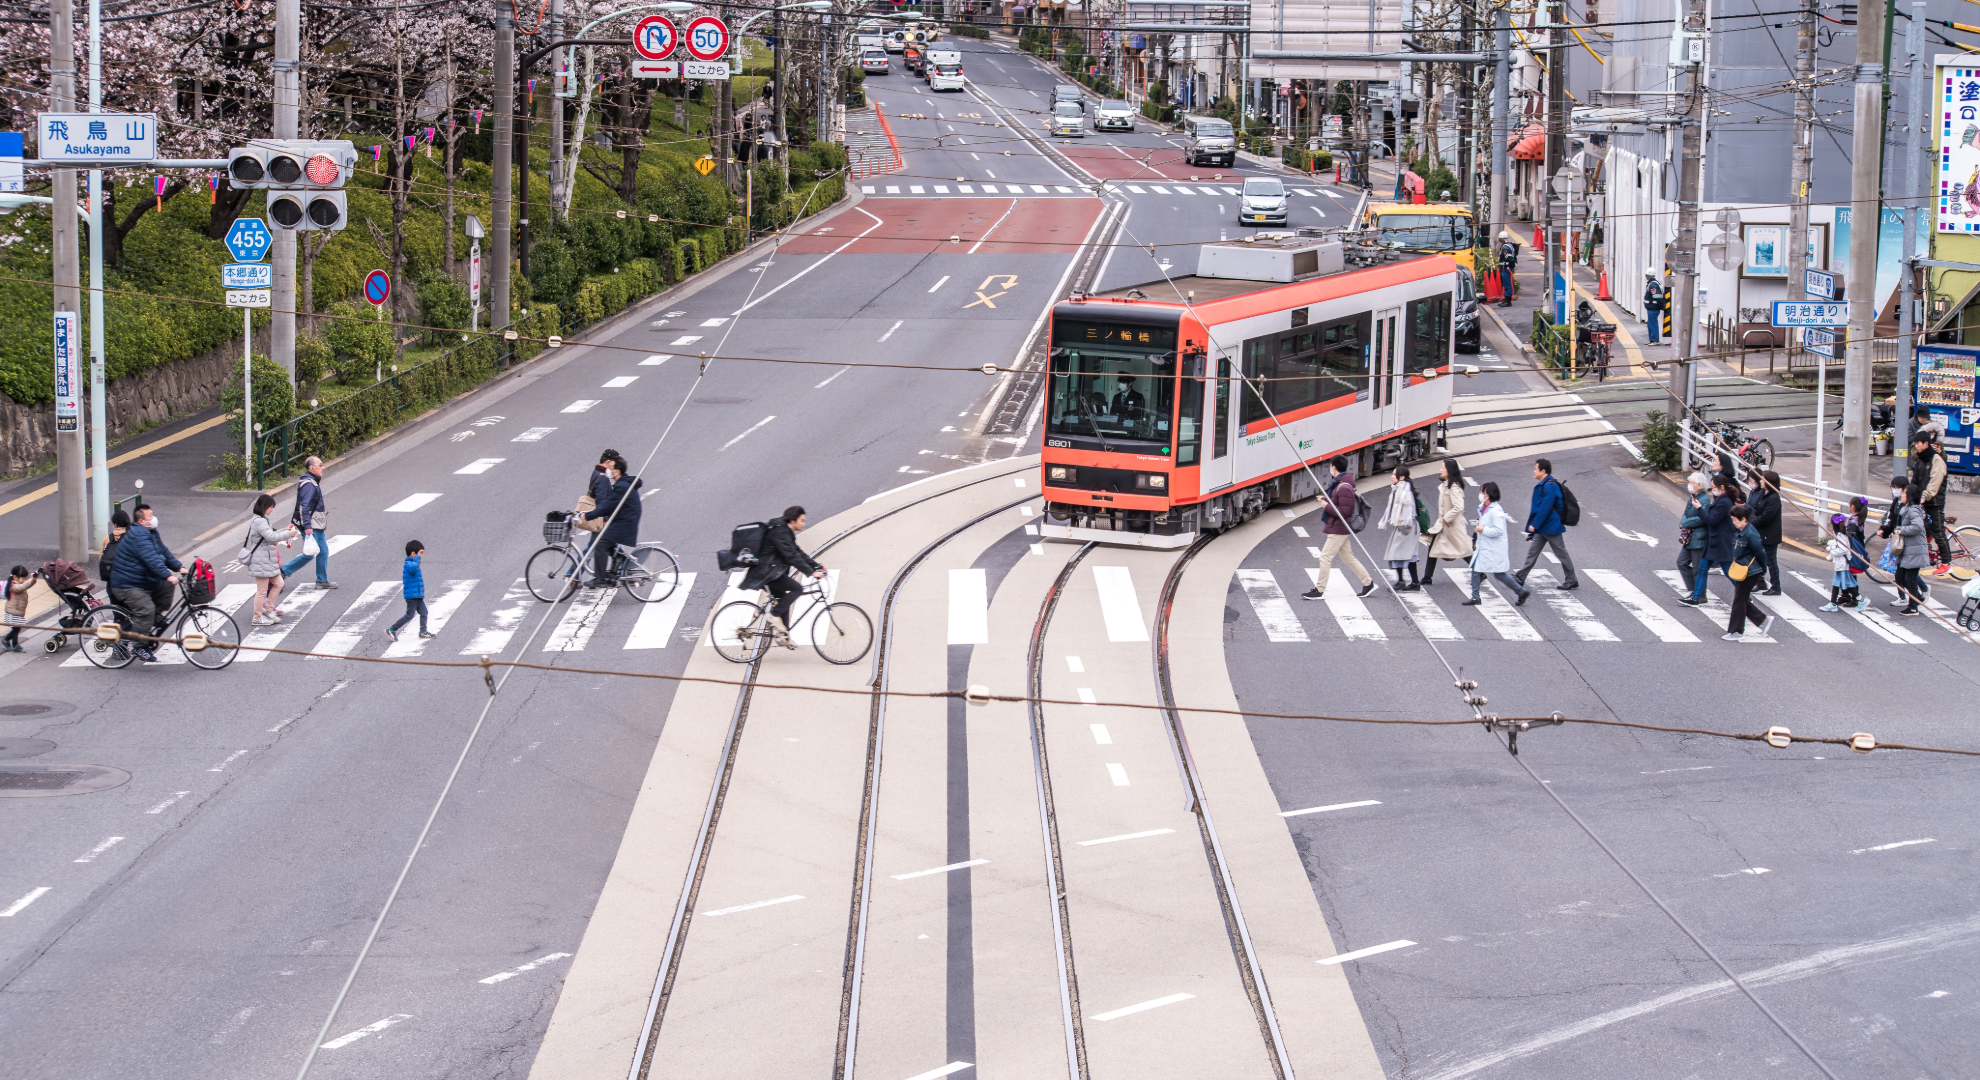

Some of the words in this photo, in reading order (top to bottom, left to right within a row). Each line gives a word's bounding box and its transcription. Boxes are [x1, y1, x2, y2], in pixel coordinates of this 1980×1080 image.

[695, 29, 718, 48] 50
[687, 65, 725, 75] ここから
[48, 120, 145, 140] 飛鳥山
[64, 143, 131, 156] Asukayama
[232, 230, 265, 248] 455
[239, 249, 259, 257] 東京
[225, 267, 268, 278] 本郷通り
[229, 293, 268, 304] ここから
[1785, 304, 1838, 317] 明治通り
[1787, 316, 1818, 325] Meiji-dori
[1086, 327, 1150, 342] 三ノ輪橋
[56, 318, 68, 396] やました整形外科
